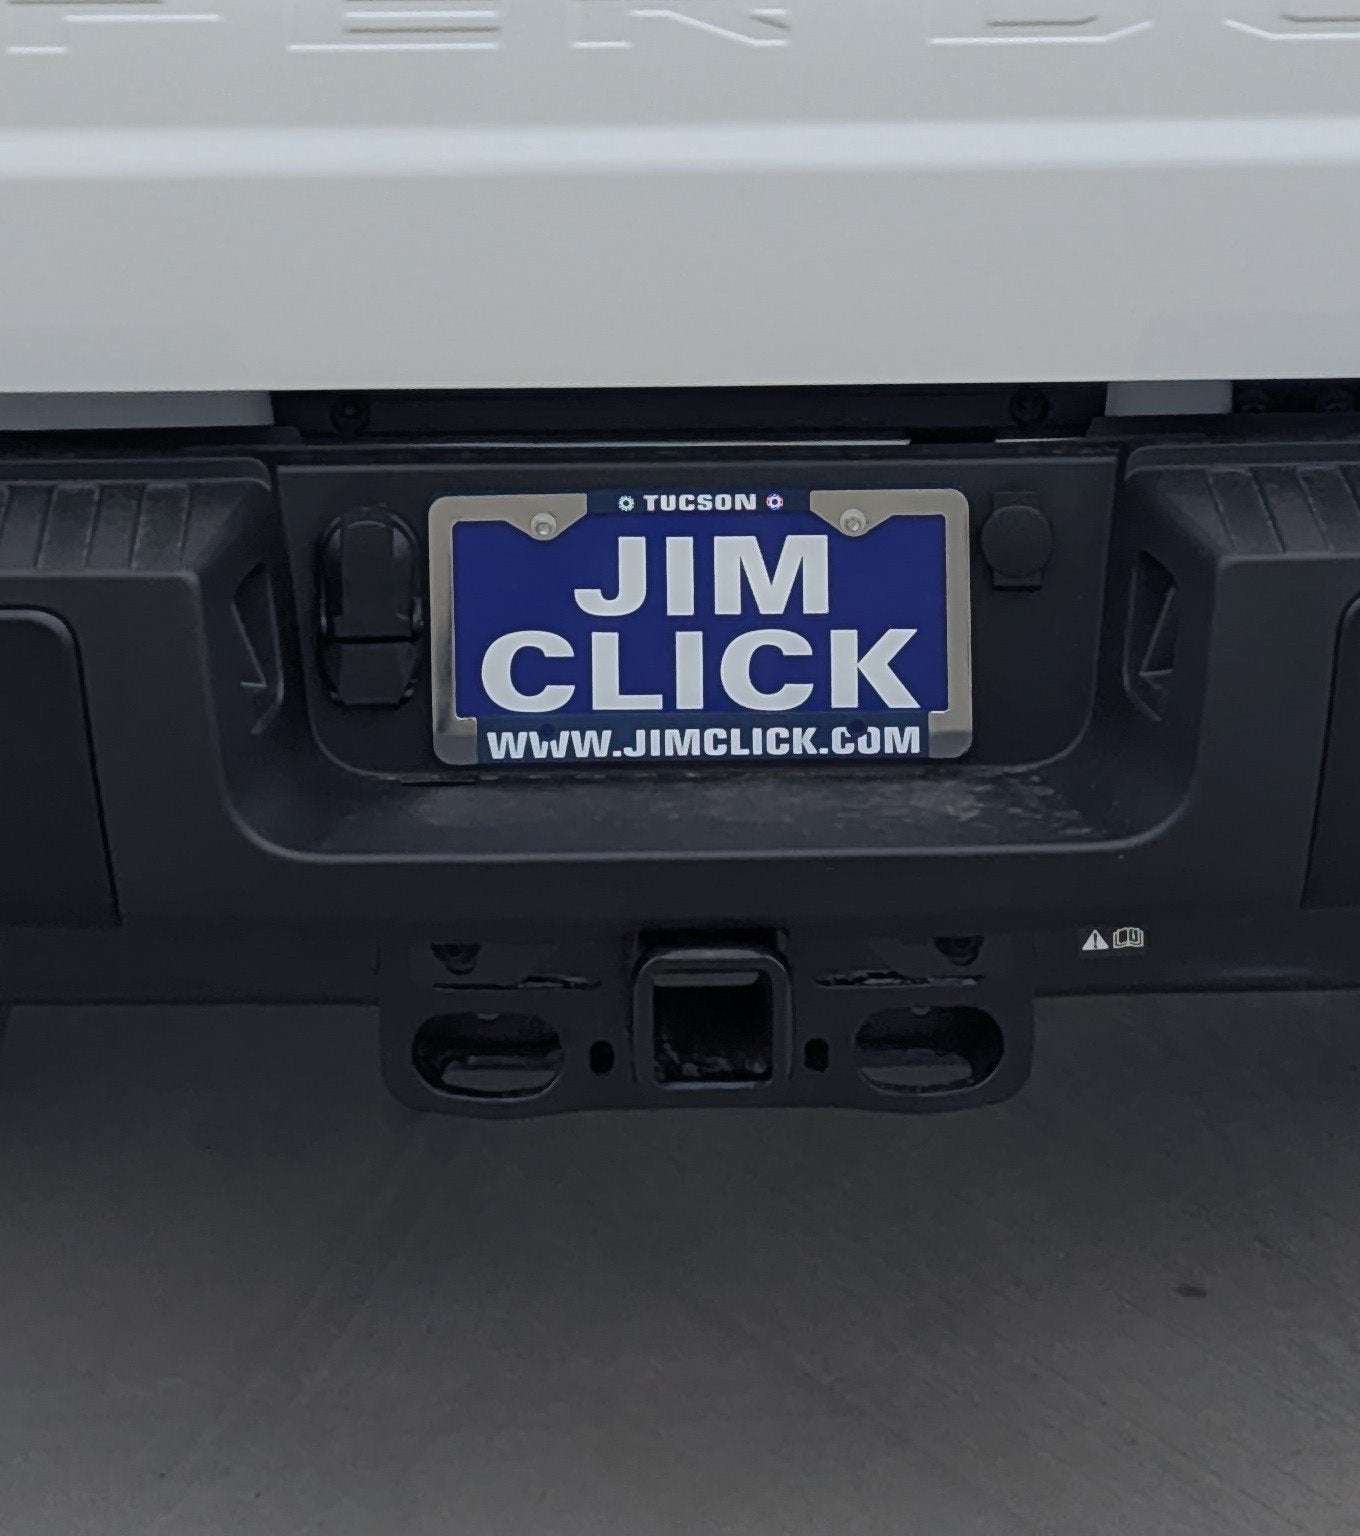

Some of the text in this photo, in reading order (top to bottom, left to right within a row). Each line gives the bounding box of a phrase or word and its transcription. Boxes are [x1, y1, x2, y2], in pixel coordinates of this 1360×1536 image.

[642, 492, 758, 513] TUCSON
[572, 533, 830, 617] JIM
[479, 627, 922, 714] CLICK
[486, 724, 922, 760] WWW.JIMCLICK.COM
